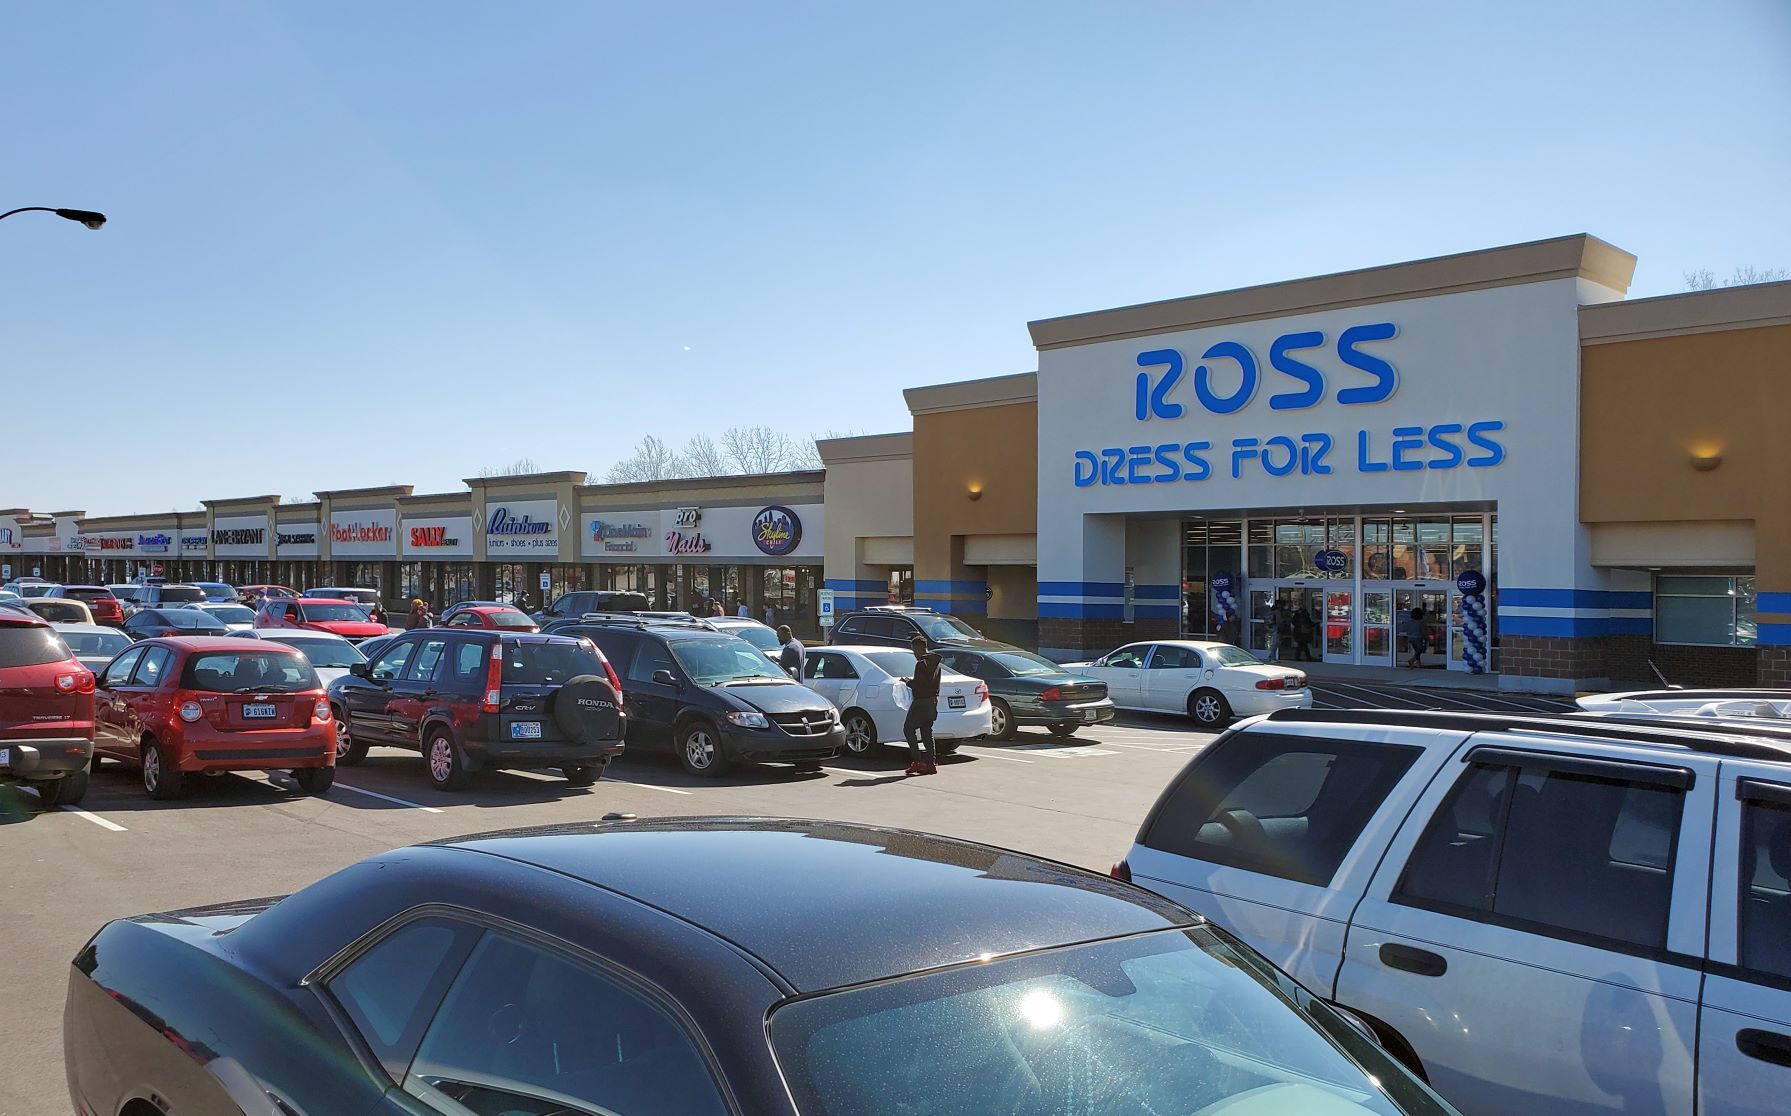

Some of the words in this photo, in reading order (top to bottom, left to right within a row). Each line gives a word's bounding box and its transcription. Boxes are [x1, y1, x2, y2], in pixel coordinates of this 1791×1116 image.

[1136, 322, 1398, 421] ROSS
[1074, 441, 1213, 488] DRESS
[1232, 433, 1334, 479] FOR
[1358, 420, 1505, 473] LESS
[487, 506, 551, 534] Rainbow
[330, 523, 352, 543] Foot
[354, 521, 391, 544] Locker
[411, 527, 446, 546] SALLY
[489, 539, 504, 549] juniors
[511, 539, 526, 547] shoes
[533, 539, 543, 548] plus
[545, 539, 557, 547] sizes
[665, 531, 709, 555] Nails
[758, 521, 791, 549] Skyline
[1326, 555, 1345, 566] ROSS
[577, 698, 615, 709] HONDA
